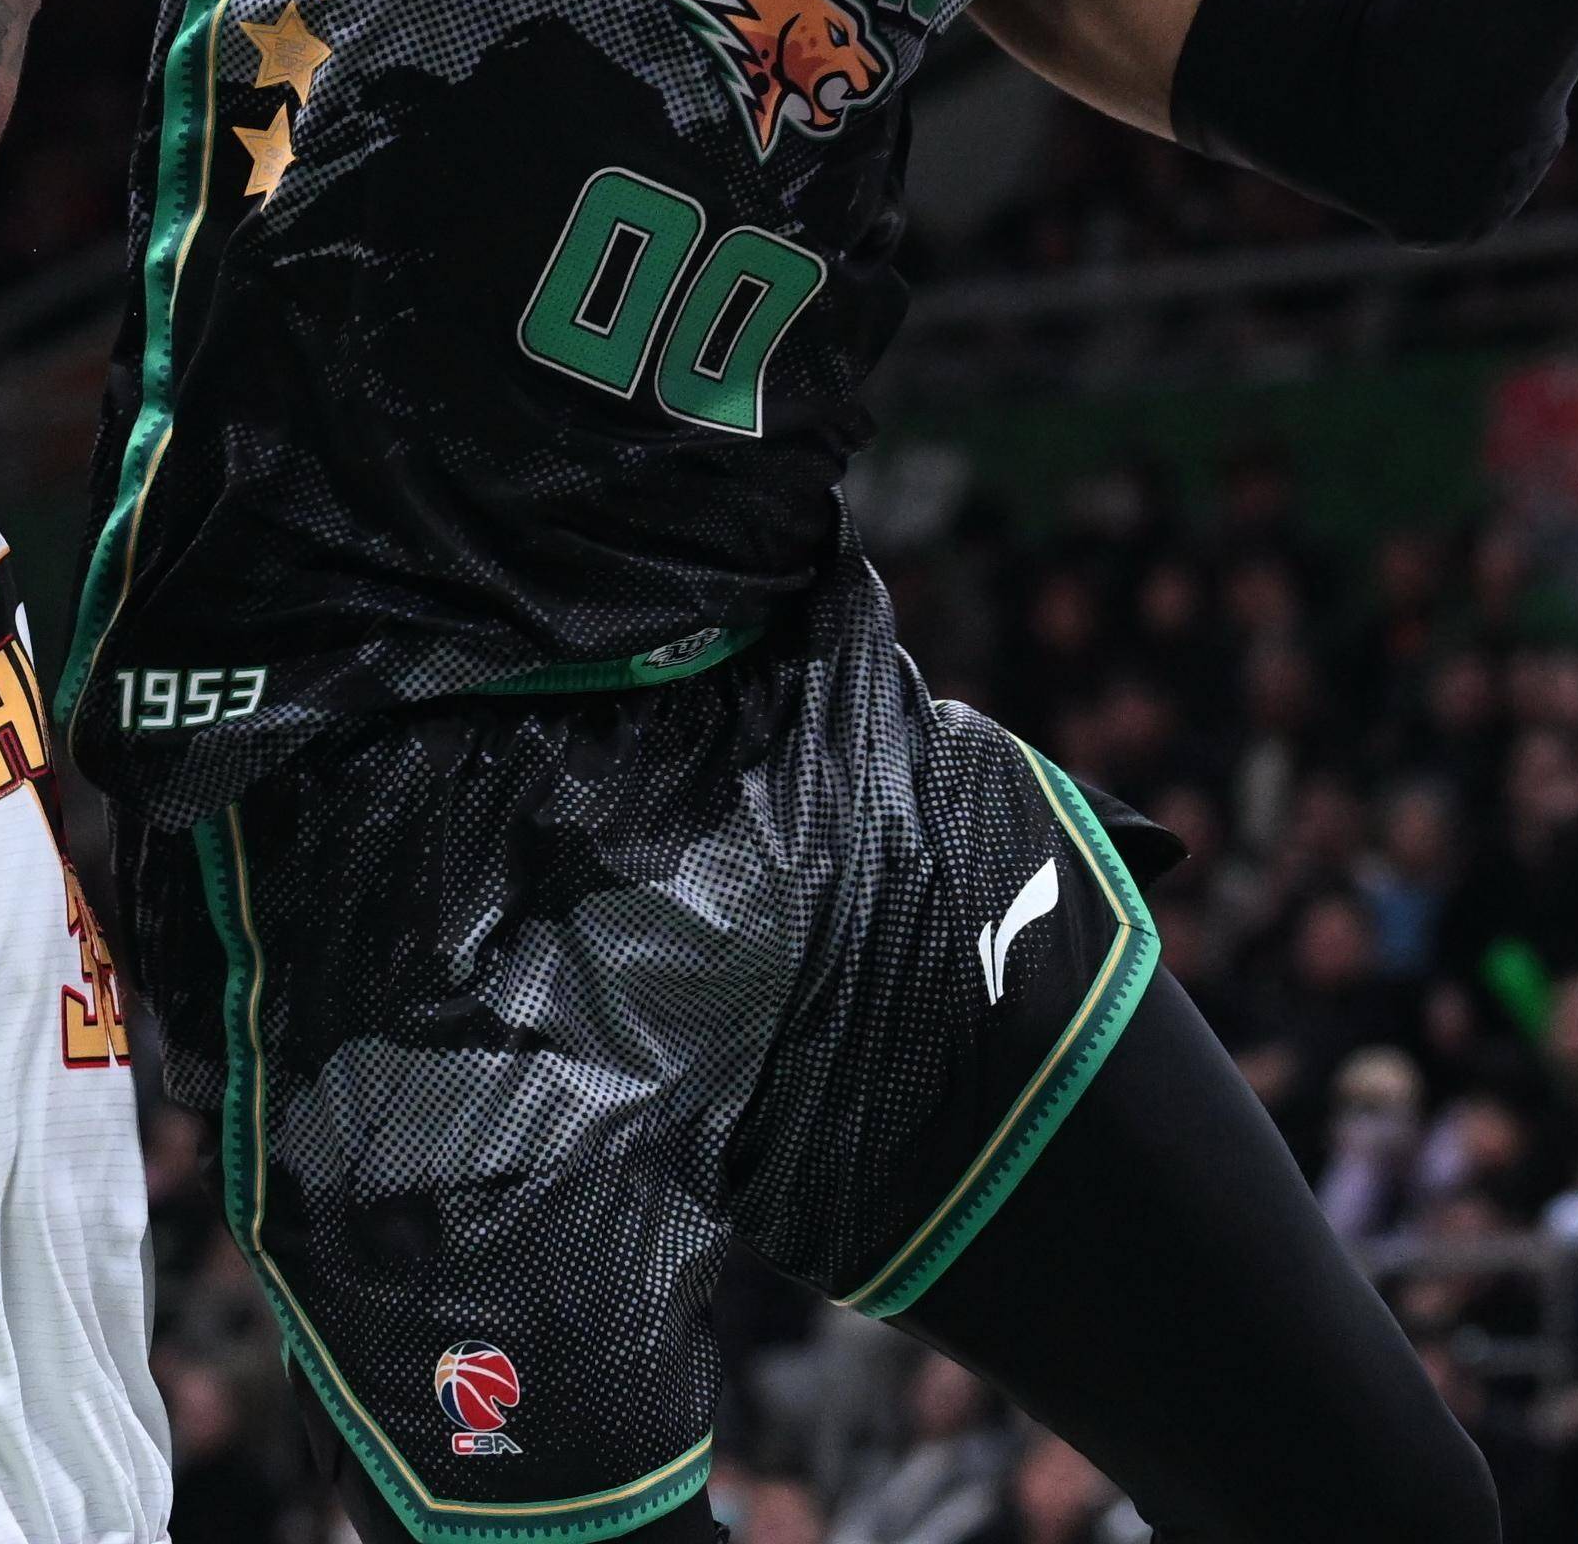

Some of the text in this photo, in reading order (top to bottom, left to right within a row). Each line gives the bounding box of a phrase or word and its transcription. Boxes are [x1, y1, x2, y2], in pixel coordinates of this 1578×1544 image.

[516, 165, 828, 438] 00
[115, 667, 268, 732] 1953
[452, 1432, 524, 1455] CBA
